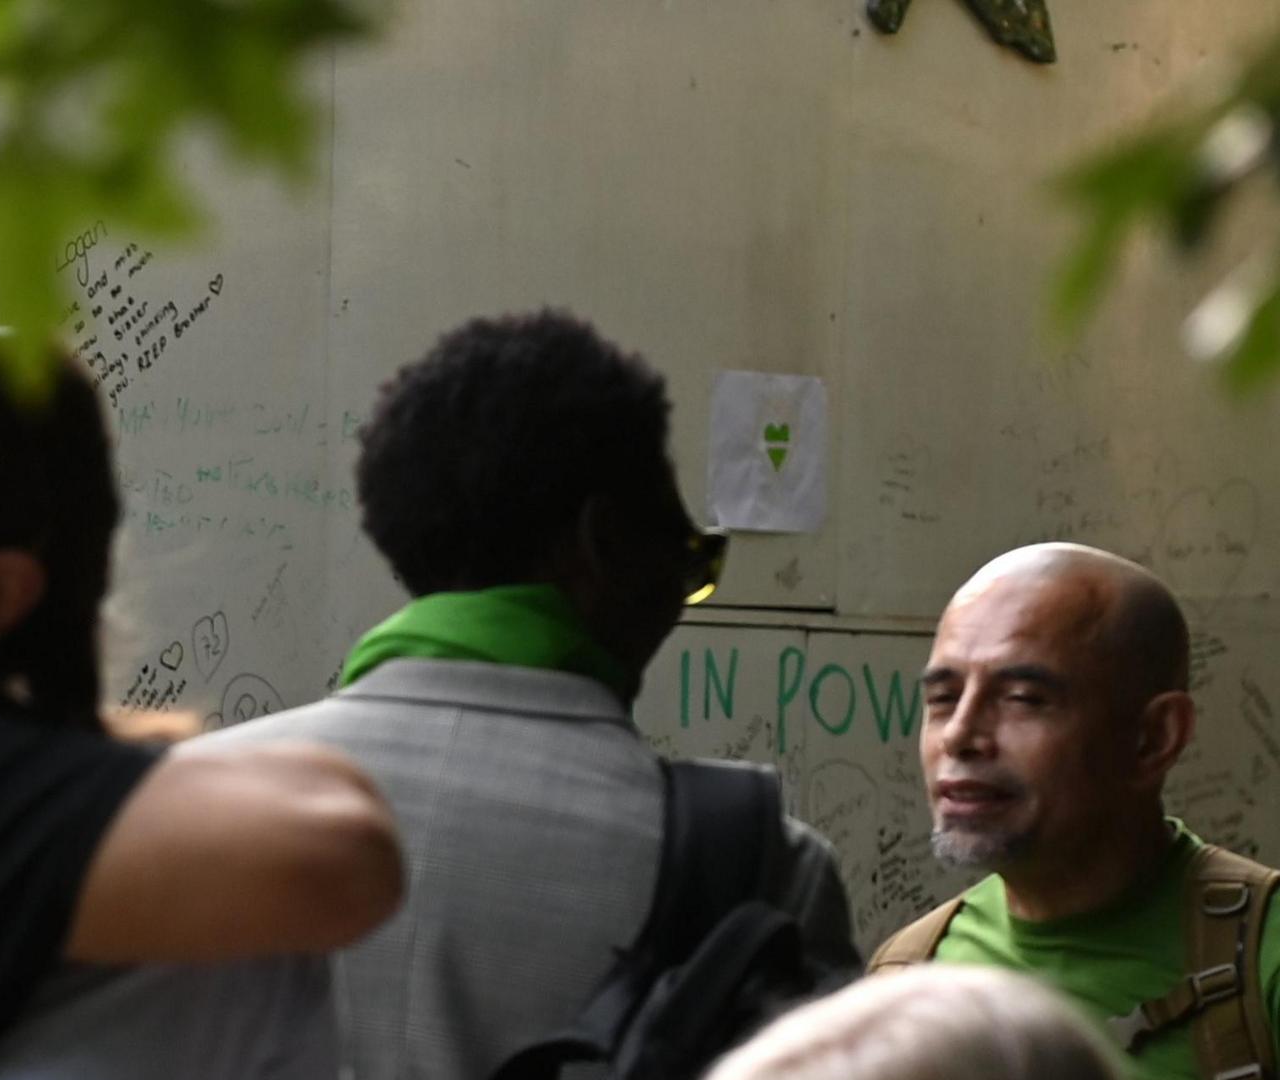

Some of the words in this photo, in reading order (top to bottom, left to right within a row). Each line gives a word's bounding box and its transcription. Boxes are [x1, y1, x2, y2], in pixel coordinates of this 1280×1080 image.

[56, 220, 108, 287] Logan
[679, 646, 740, 728] IN
[776, 645, 927, 754] POW
